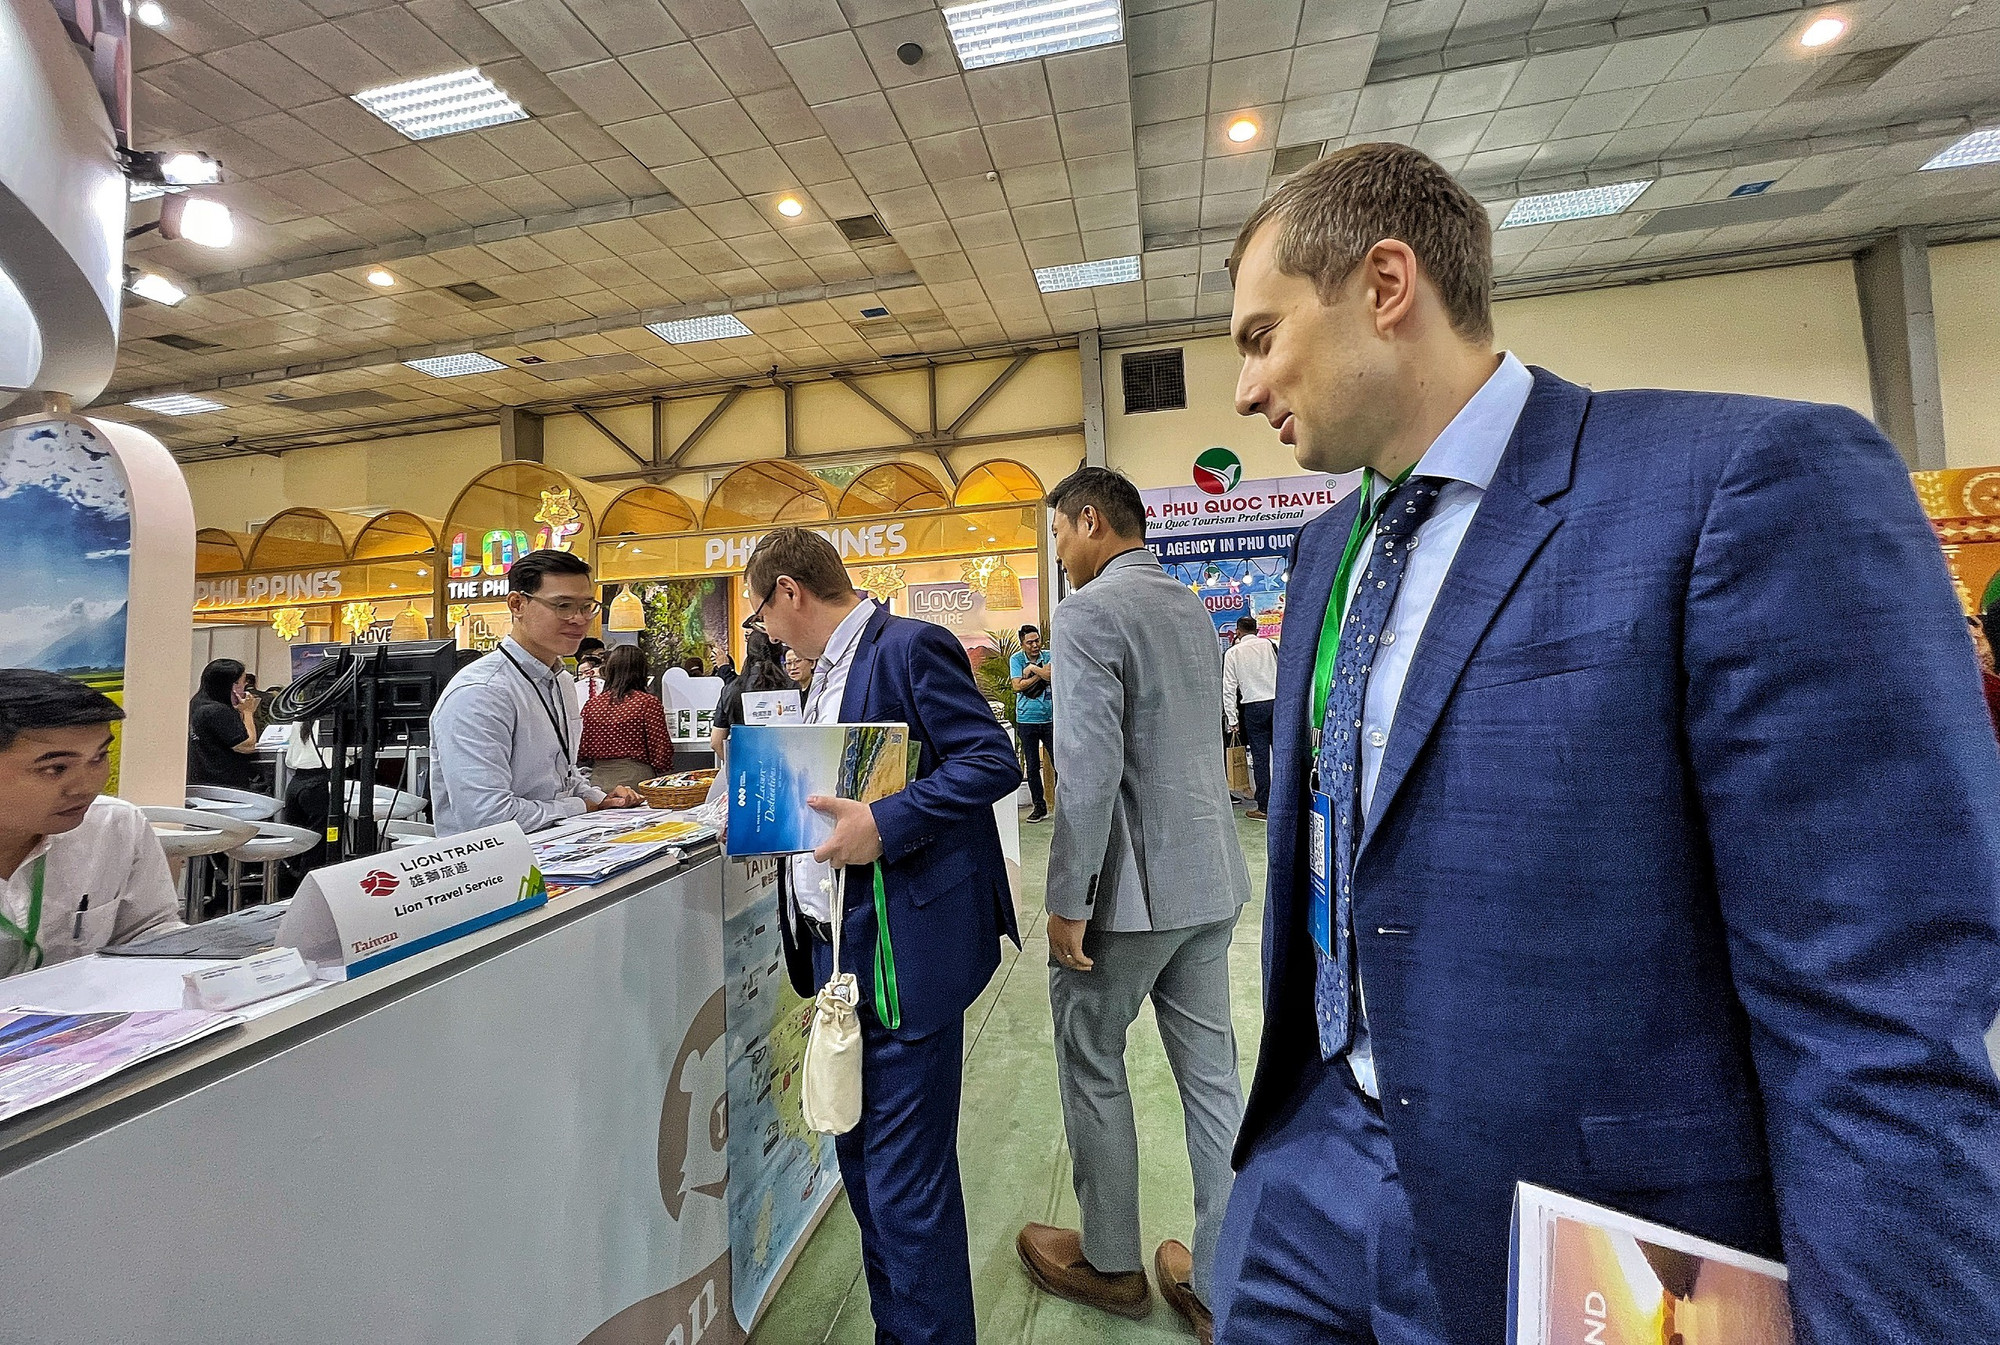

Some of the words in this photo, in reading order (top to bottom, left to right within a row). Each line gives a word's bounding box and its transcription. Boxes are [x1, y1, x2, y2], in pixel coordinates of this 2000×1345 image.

[1163, 502, 1198, 517] PHU
[1205, 497, 1262, 514] QUOC
[1268, 491, 1335, 508] TRAVEL
[1165, 520, 1190, 530] Quoc
[1192, 516, 1235, 526] Tourism
[1238, 510, 1304, 522] Professional
[452, 522, 583, 578] LOVE
[1146, 543, 1164, 557] EL
[1166, 539, 1216, 556] AGENCY
[1220, 538, 1235, 552] IN
[1238, 536, 1264, 550] PHU
[194, 570, 342, 606] PHILIPPINES
[447, 581, 479, 599] THE
[915, 588, 974, 613] LOVE
[1204, 595, 1243, 611] QUOC
[400, 853, 444, 872] LION
[443, 837, 504, 859] TRAVEL
[409, 861, 470, 888] 雄獅旅遊
[394, 901, 423, 917] Lion
[424, 887, 463, 907] Travel
[465, 875, 504, 894] Service
[351, 931, 398, 953] Taiwan
